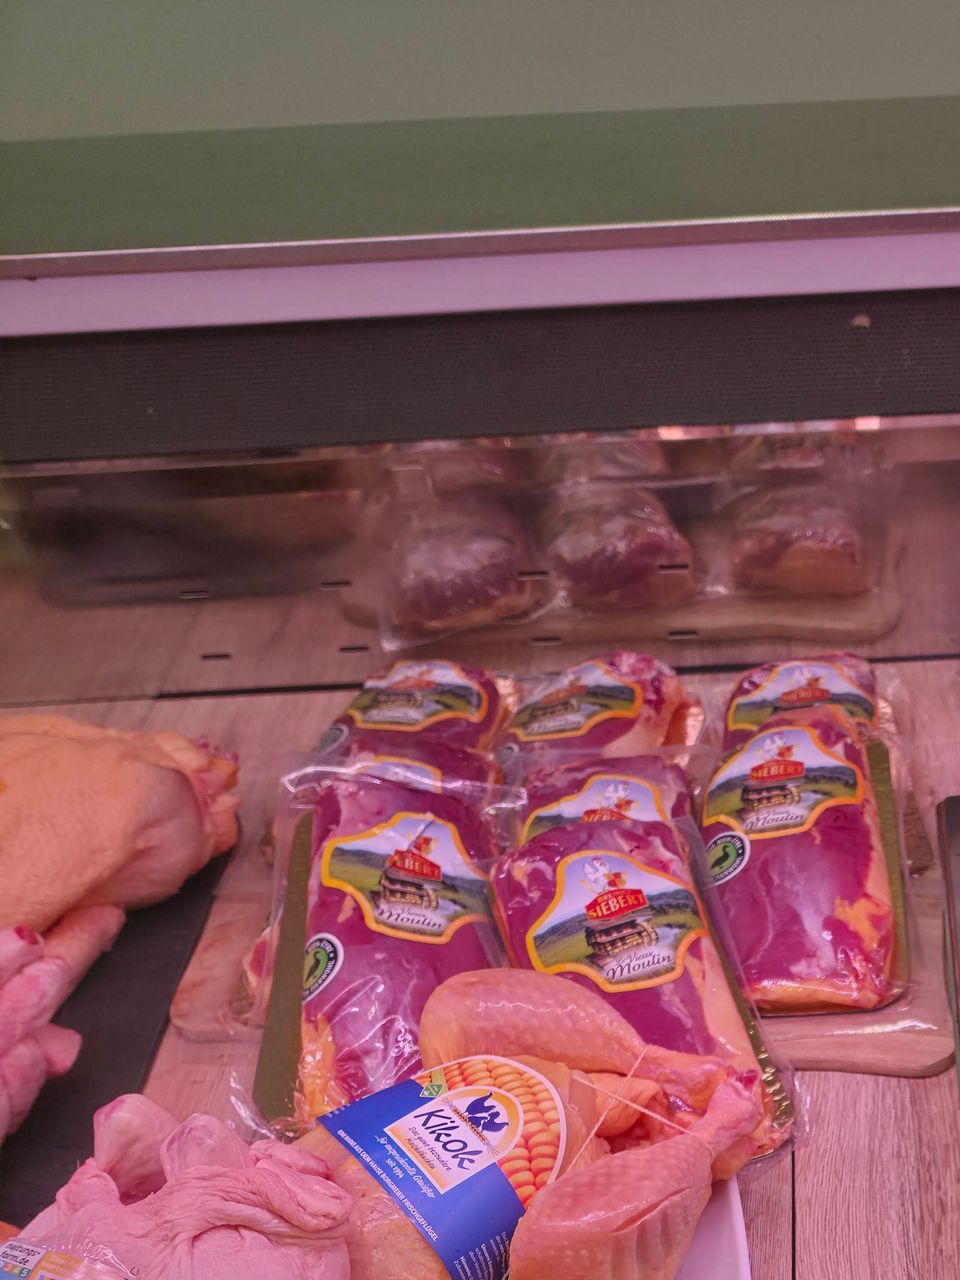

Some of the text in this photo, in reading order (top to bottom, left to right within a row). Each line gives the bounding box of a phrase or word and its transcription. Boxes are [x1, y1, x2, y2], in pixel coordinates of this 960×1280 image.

[588, 893, 645, 918] SIEBERT
[379, 908, 443, 929] Moulin
[606, 954, 673, 981] Moulin
[360, 1151, 372, 1163] DEM
[369, 1159, 383, 1176] HAUSE
[380, 1172, 405, 1201] BORGMEIER
[402, 1197, 438, 1241] FRISCHGEFLÜGEL
[20, 1268, 28, 1277] 5
